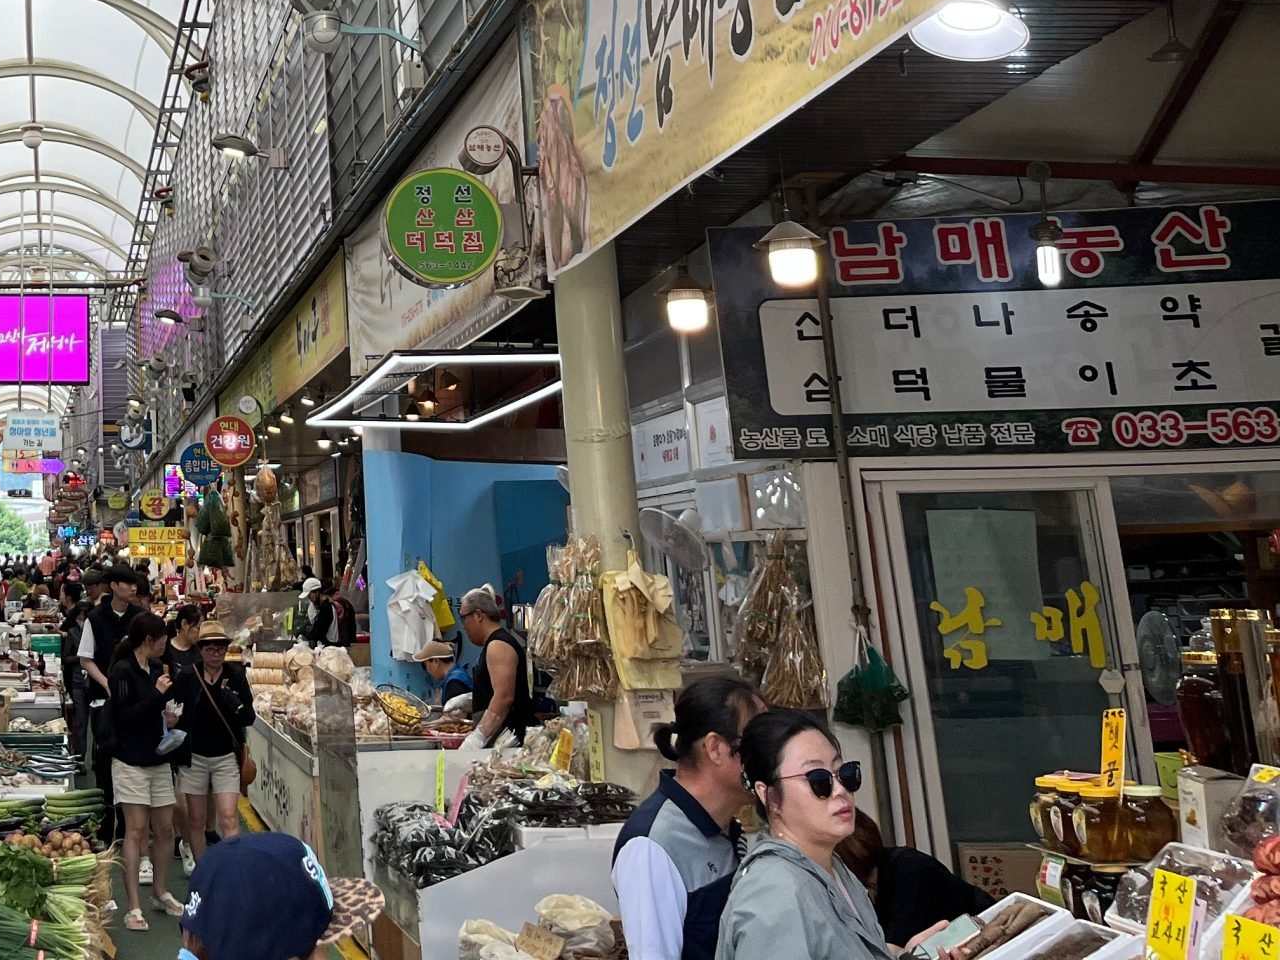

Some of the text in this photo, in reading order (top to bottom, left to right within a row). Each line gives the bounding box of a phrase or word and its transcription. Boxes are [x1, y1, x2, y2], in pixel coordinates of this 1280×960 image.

[414, 207, 476, 229] 산삼
[404, 230, 486, 254] 더덕집
[830, 206, 1232, 285] 남매농산
[210, 434, 251, 450] 건강원
[740, 427, 801, 450] 농산물
[846, 423, 890, 448] 소매
[893, 423, 937, 448] 식당
[941, 423, 986, 447] 납품
[990, 421, 1036, 446] 전문
[184, 459, 219, 473] 종합마트
[930, 582, 1107, 670] 남매
